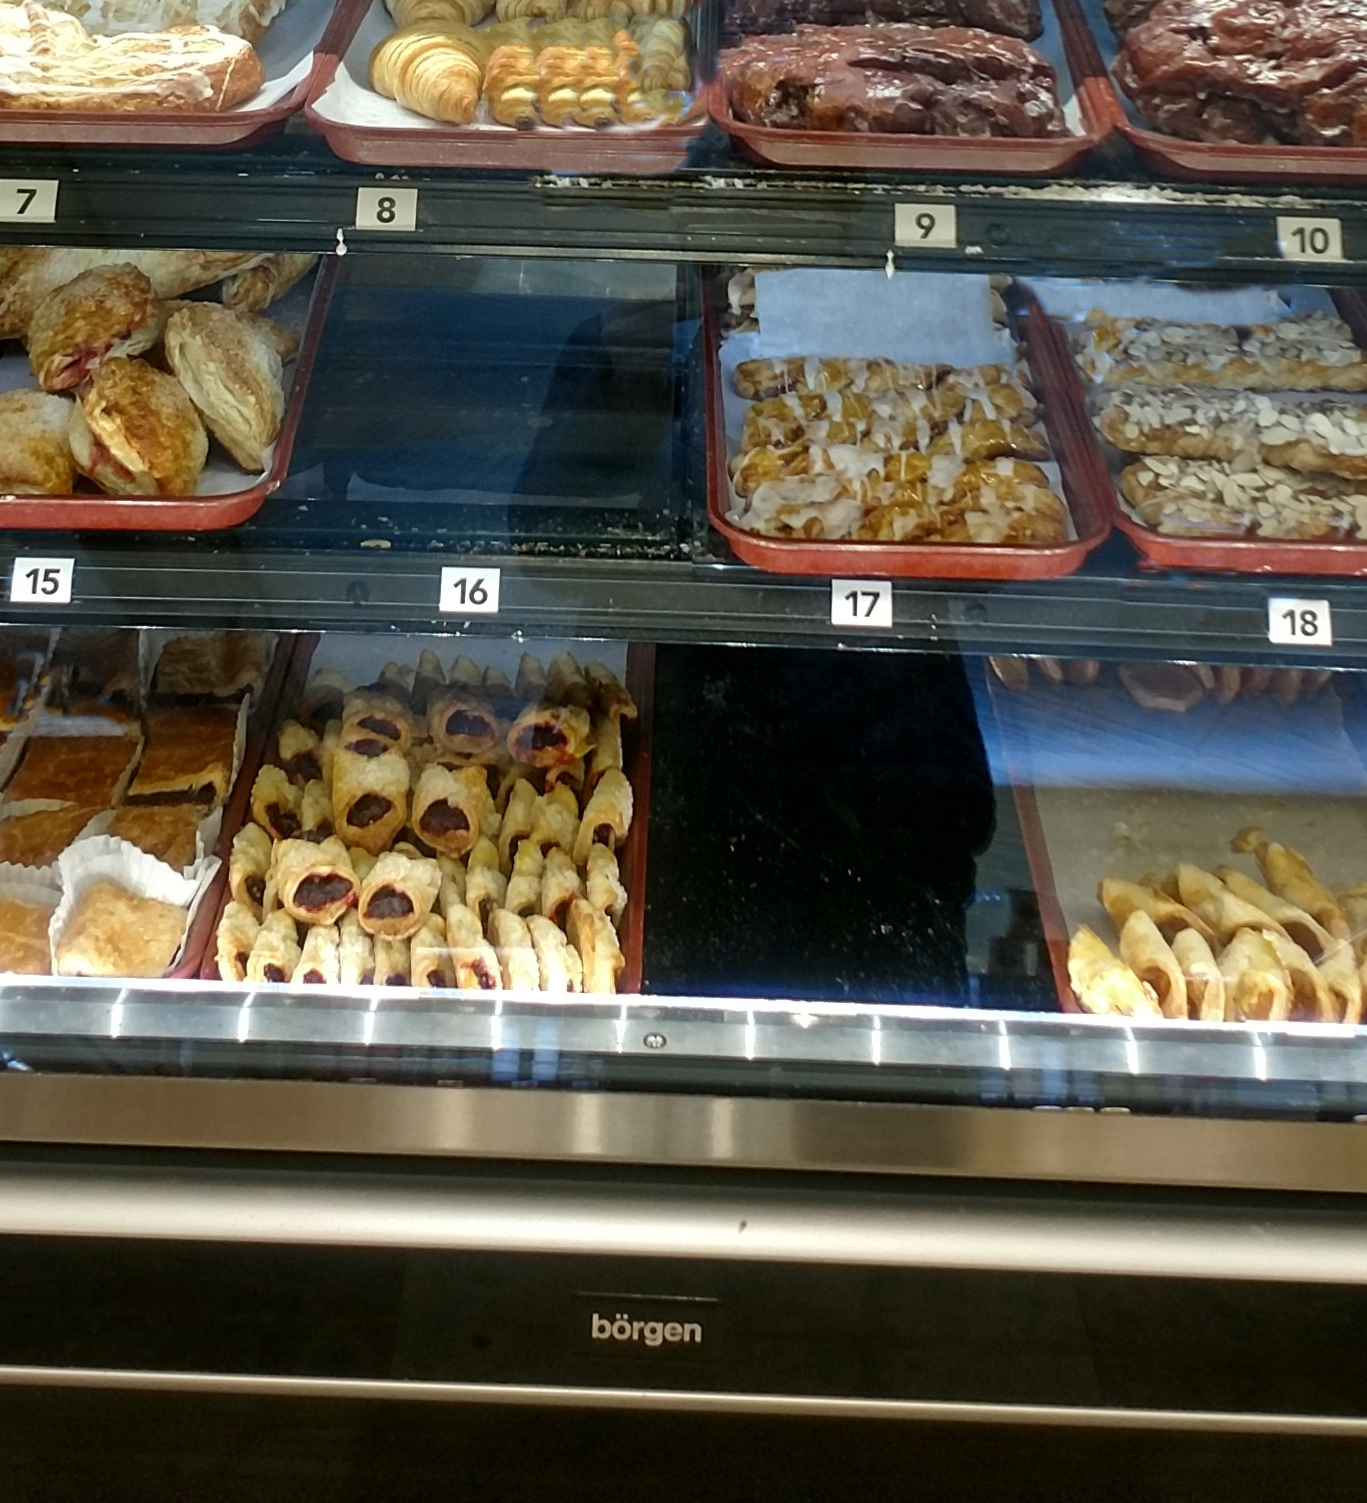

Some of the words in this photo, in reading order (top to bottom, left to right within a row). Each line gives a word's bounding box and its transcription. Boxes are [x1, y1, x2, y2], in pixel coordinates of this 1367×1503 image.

[17, 189, 38, 215] 7
[377, 197, 396, 224] 8
[916, 213, 936, 239] 9
[1292, 227, 1330, 255] 10
[25, 569, 61, 596] 15
[453, 579, 488, 606] 16
[844, 591, 881, 618] 17
[1282, 610, 1319, 637] 18
[591, 1313, 702, 1346] börgen
